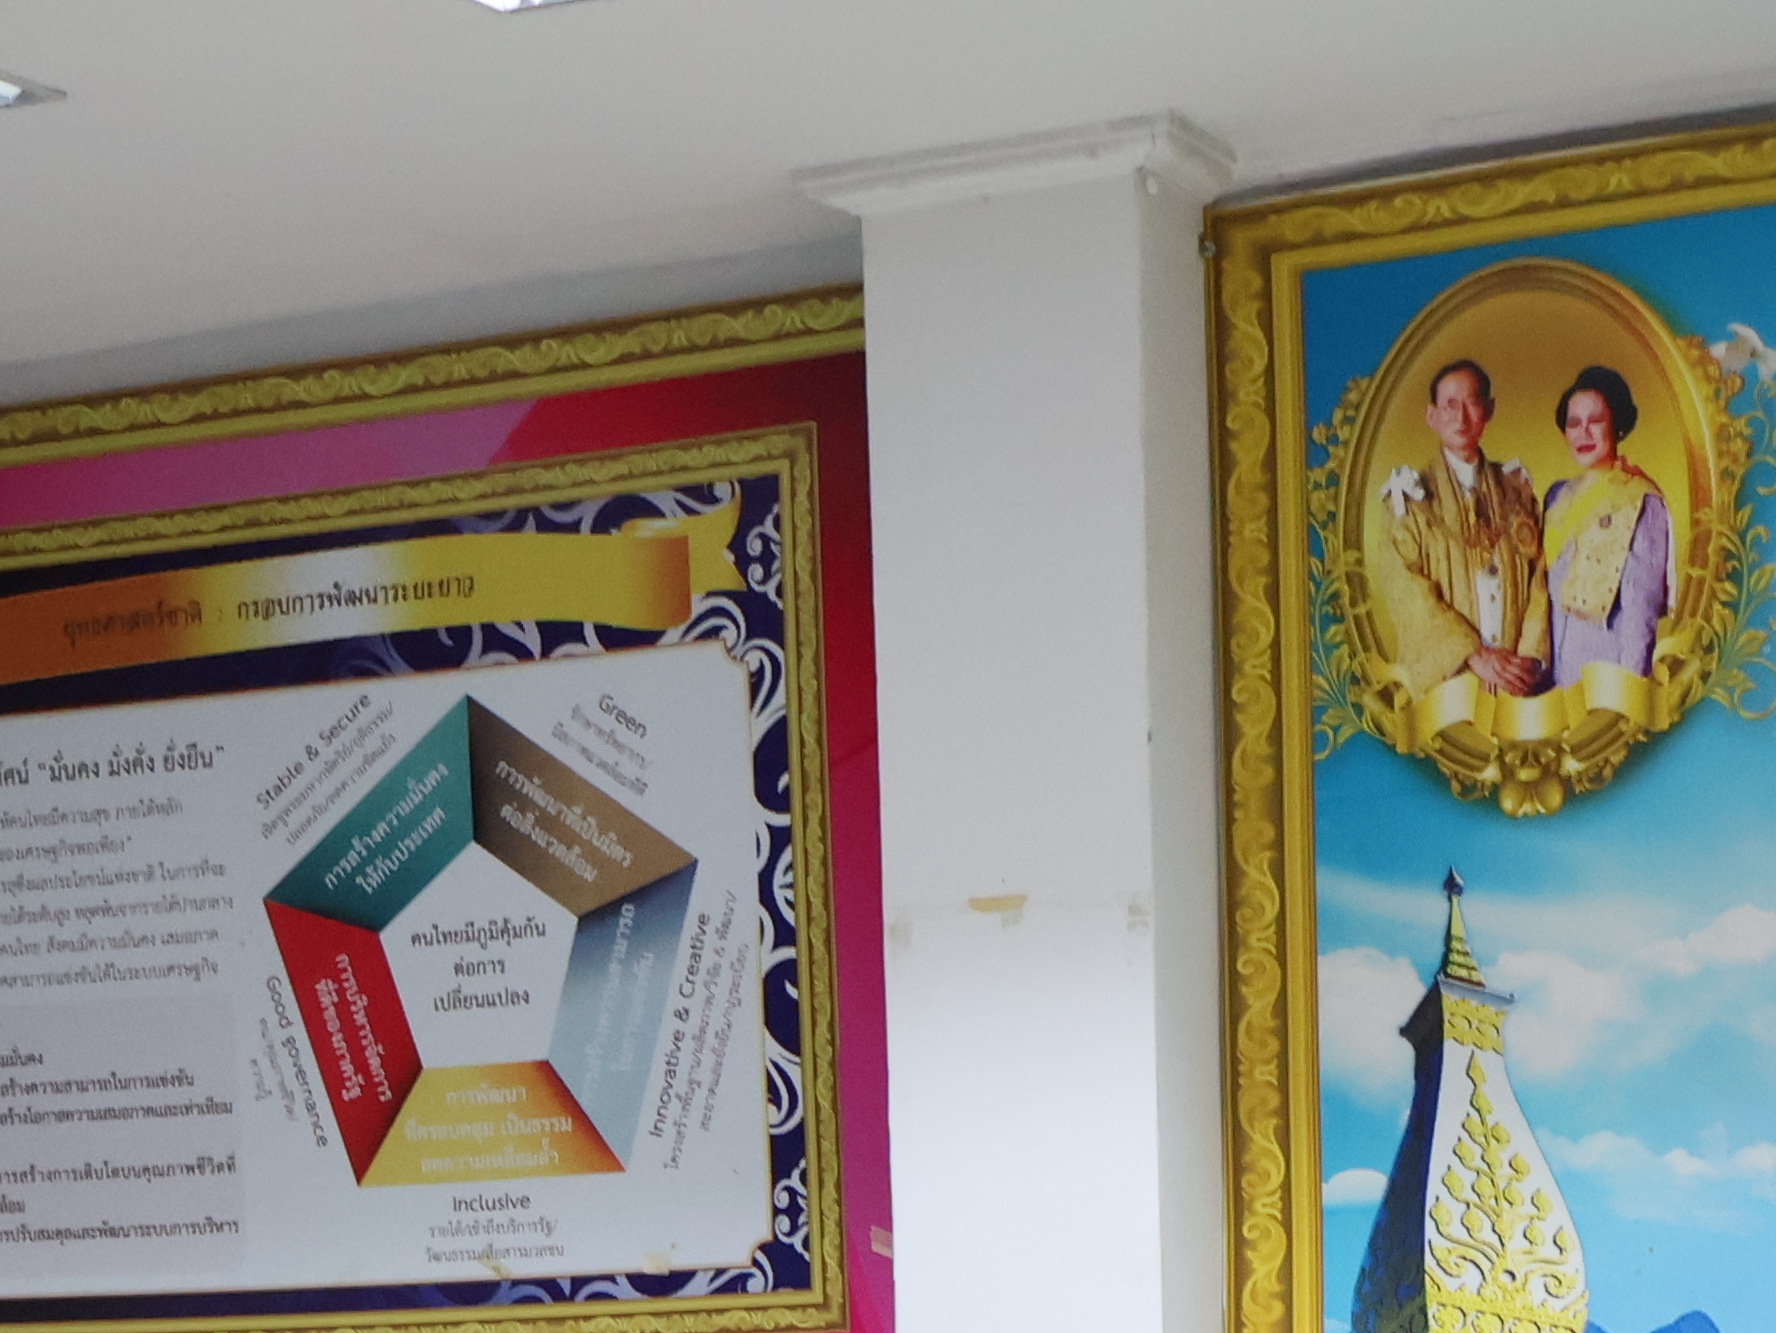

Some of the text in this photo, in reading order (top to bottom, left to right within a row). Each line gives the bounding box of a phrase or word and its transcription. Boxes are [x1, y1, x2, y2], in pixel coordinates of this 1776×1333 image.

[598, 693, 647, 740] Green
[256, 693, 373, 811] Stable & Secure
[453, 956, 506, 978] ต่อการ
[433, 984, 530, 1013] เปลี่ยนแปลง
[648, 911, 711, 1138] Innovative & Creative
[266, 975, 293, 1029] Good
[281, 1034, 329, 1149] governance
[452, 1192, 533, 1213] Inclusive
